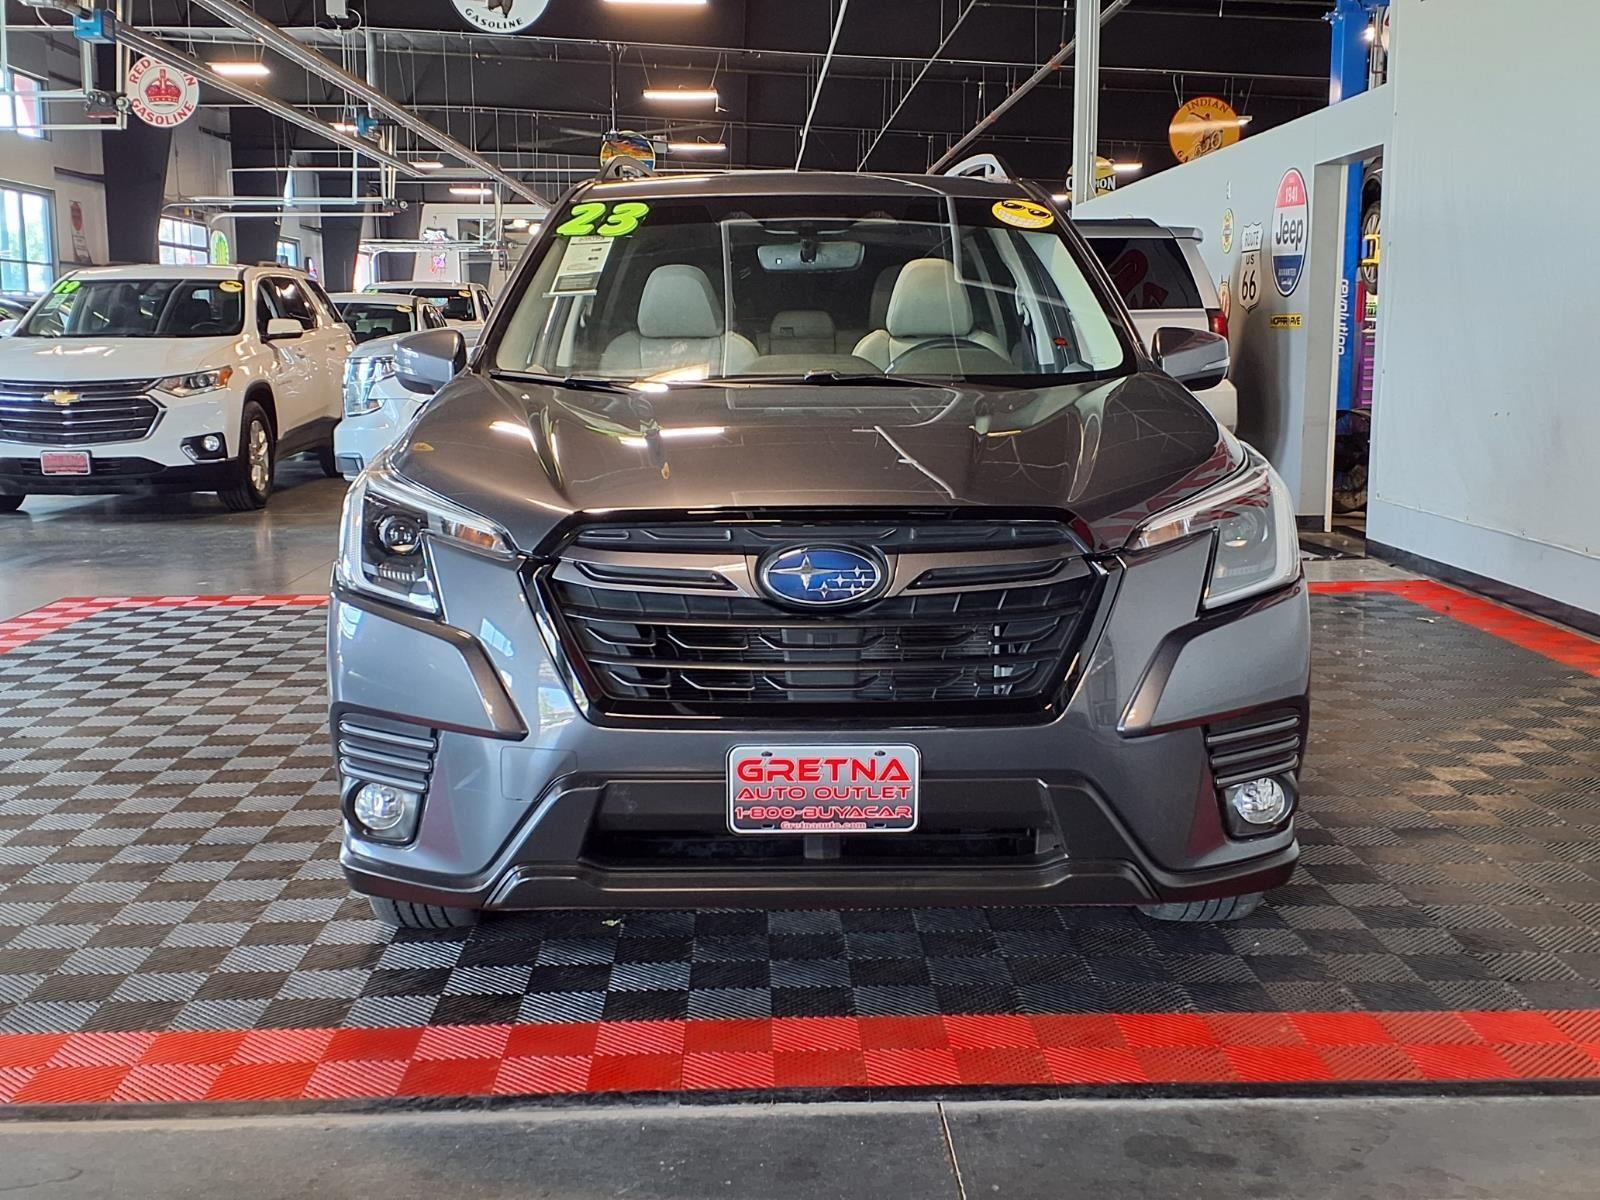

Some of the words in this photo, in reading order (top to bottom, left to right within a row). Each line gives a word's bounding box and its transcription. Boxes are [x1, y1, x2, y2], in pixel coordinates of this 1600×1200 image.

[464, 8, 524, 29] GASOLINE
[129, 59, 151, 84] RED
[131, 98, 194, 124] GASOLINE
[1186, 98, 1229, 113] INDIAN
[556, 202, 650, 236] 23
[1275, 213, 1303, 251] Jeep
[1245, 254, 1255, 265] US
[1241, 269, 1257, 300] 66
[736, 757, 911, 783] GRETNA
[735, 786, 806, 801] AUTO
[813, 786, 912, 800] OUTLET
[735, 806, 912, 819] 1-800-BUYACAR
